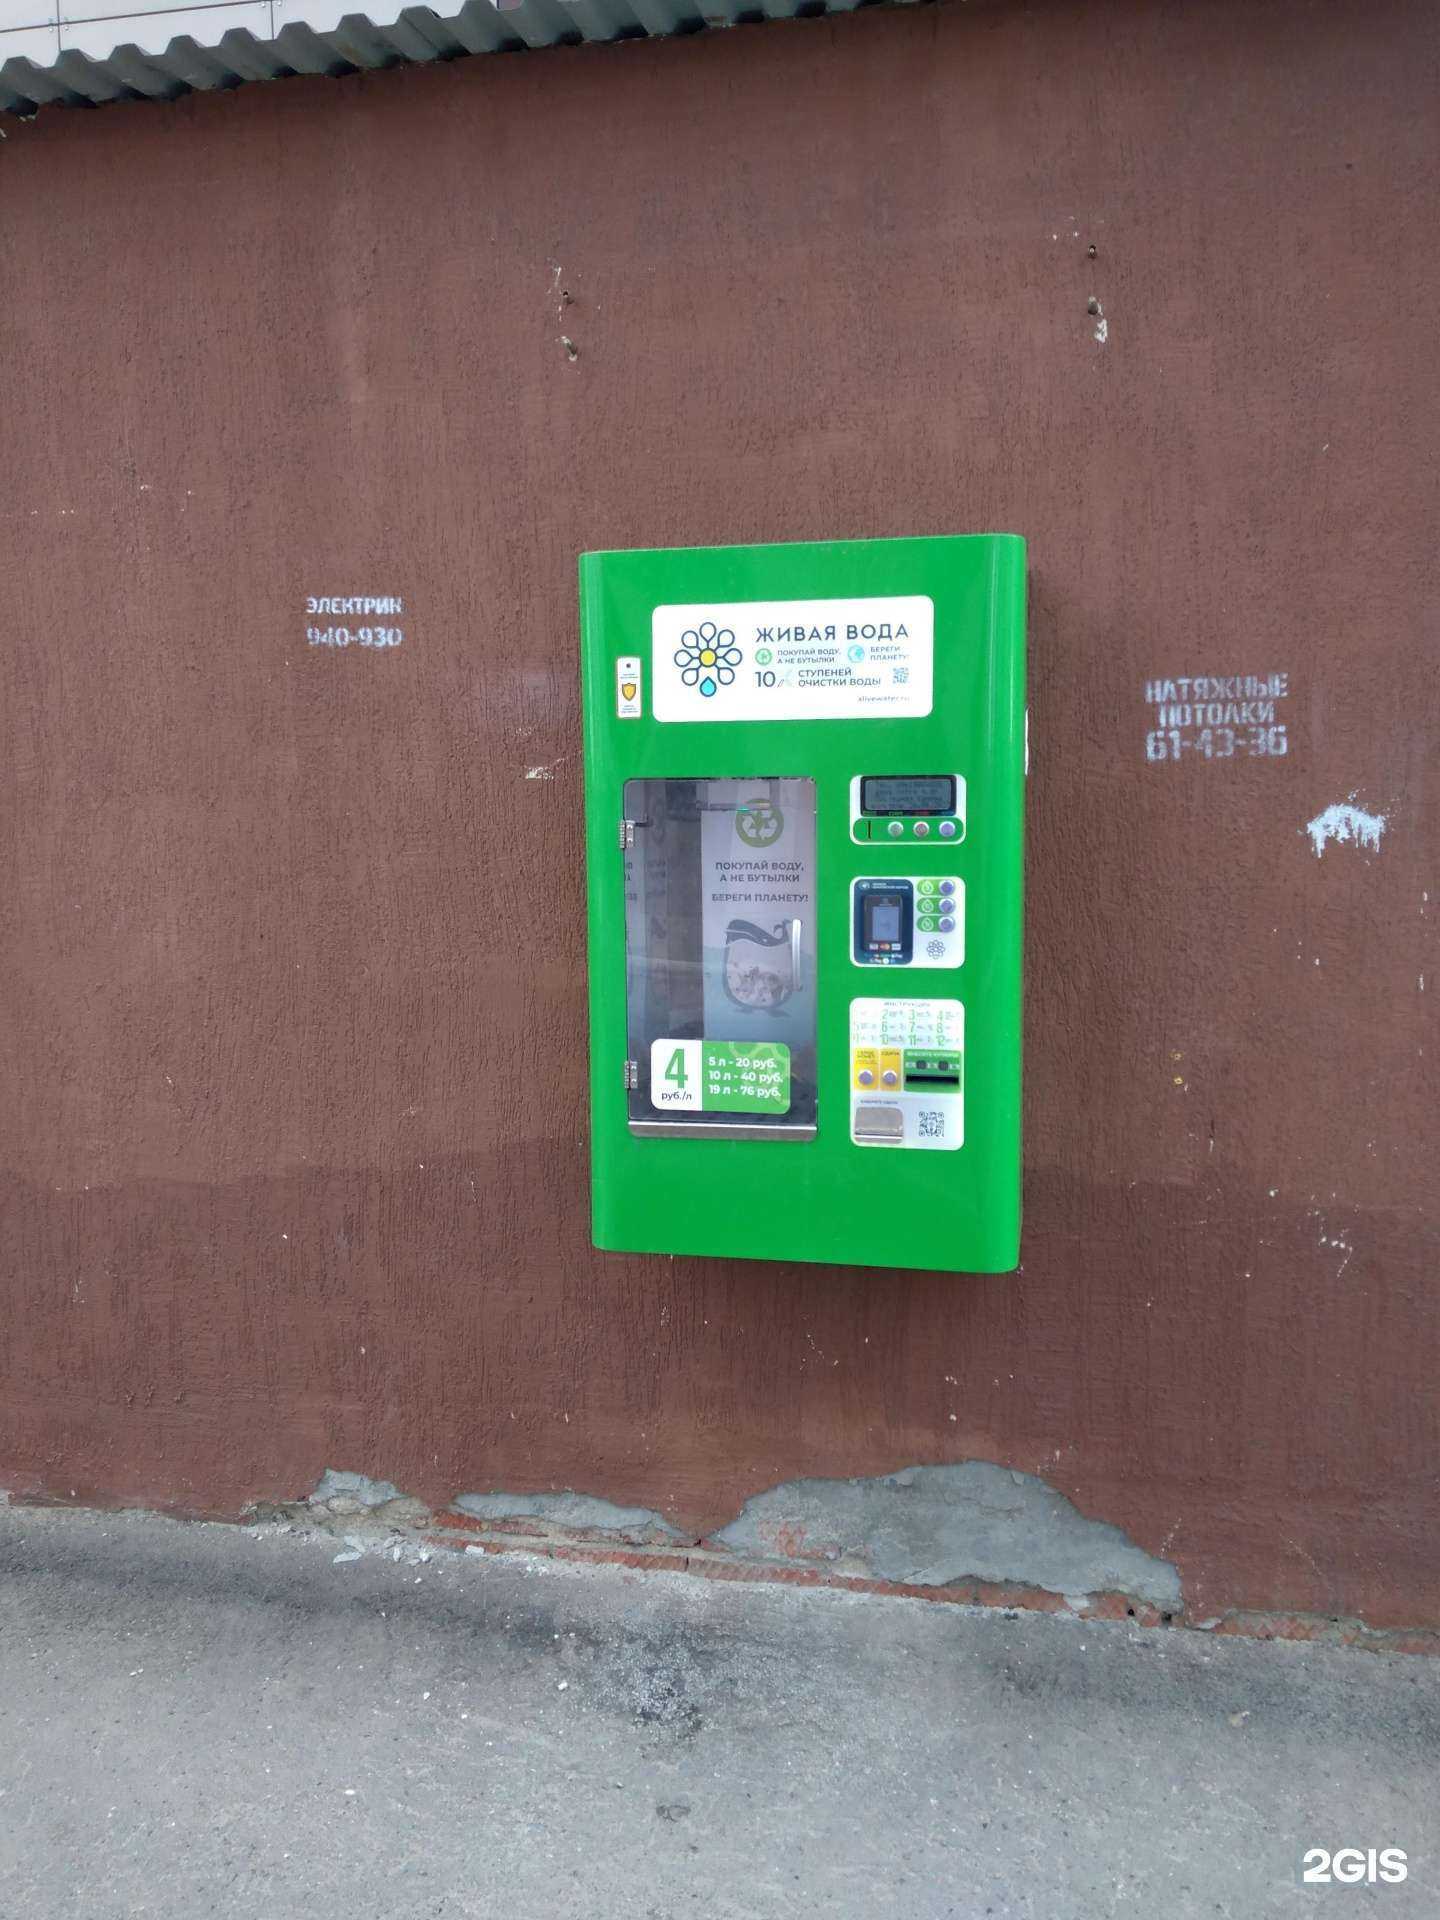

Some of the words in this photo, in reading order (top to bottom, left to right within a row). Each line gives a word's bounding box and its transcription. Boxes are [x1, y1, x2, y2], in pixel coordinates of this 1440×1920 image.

[755, 625, 836, 642] ЖИВАЯ
[846, 623, 910, 642] ВОДА
[777, 647, 816, 656] ПОКУПАЙ
[755, 670, 776, 688] 10
[798, 667, 852, 678] СТУПЕНЕЙ
[798, 678, 847, 688] ОЧИСТКИ
[849, 678, 881, 686] ВОДЫ
[1145, 672, 1288, 703] НАТЯЖНЫЕ
[1159, 701, 1275, 727] ПОТОЛКИ
[1146, 725, 1287, 761] 61-43-36
[715, 860, 768, 871] ПОКУПАЙ
[771, 862, 804, 872] ВОДУ,
[720, 874, 727, 882] А
[730, 874, 745, 882] НЕ
[747, 874, 800, 882] БУТЫЛКИ
[712, 893, 752, 902] БЕРЕГИ
[754, 894, 809, 903] ПЛАНЕТУ!
[665, 1048, 688, 1088] 4
[709, 1056, 716, 1066] 5
[718, 1058, 726, 1066] л
[736, 1058, 750, 1068] 20
[753, 1057, 777, 1071] руб.
[709, 1070, 720, 1080] 10
[723, 1072, 731, 1080] л
[741, 1072, 756, 1081] 40
[759, 1072, 783, 1084] руб.
[661, 1091, 692, 1101] руб./л
[709, 1084, 720, 1094] 19
[723, 1086, 731, 1095] л
[741, 1086, 755, 1096] 76
[757, 1086, 782, 1099] руб.
